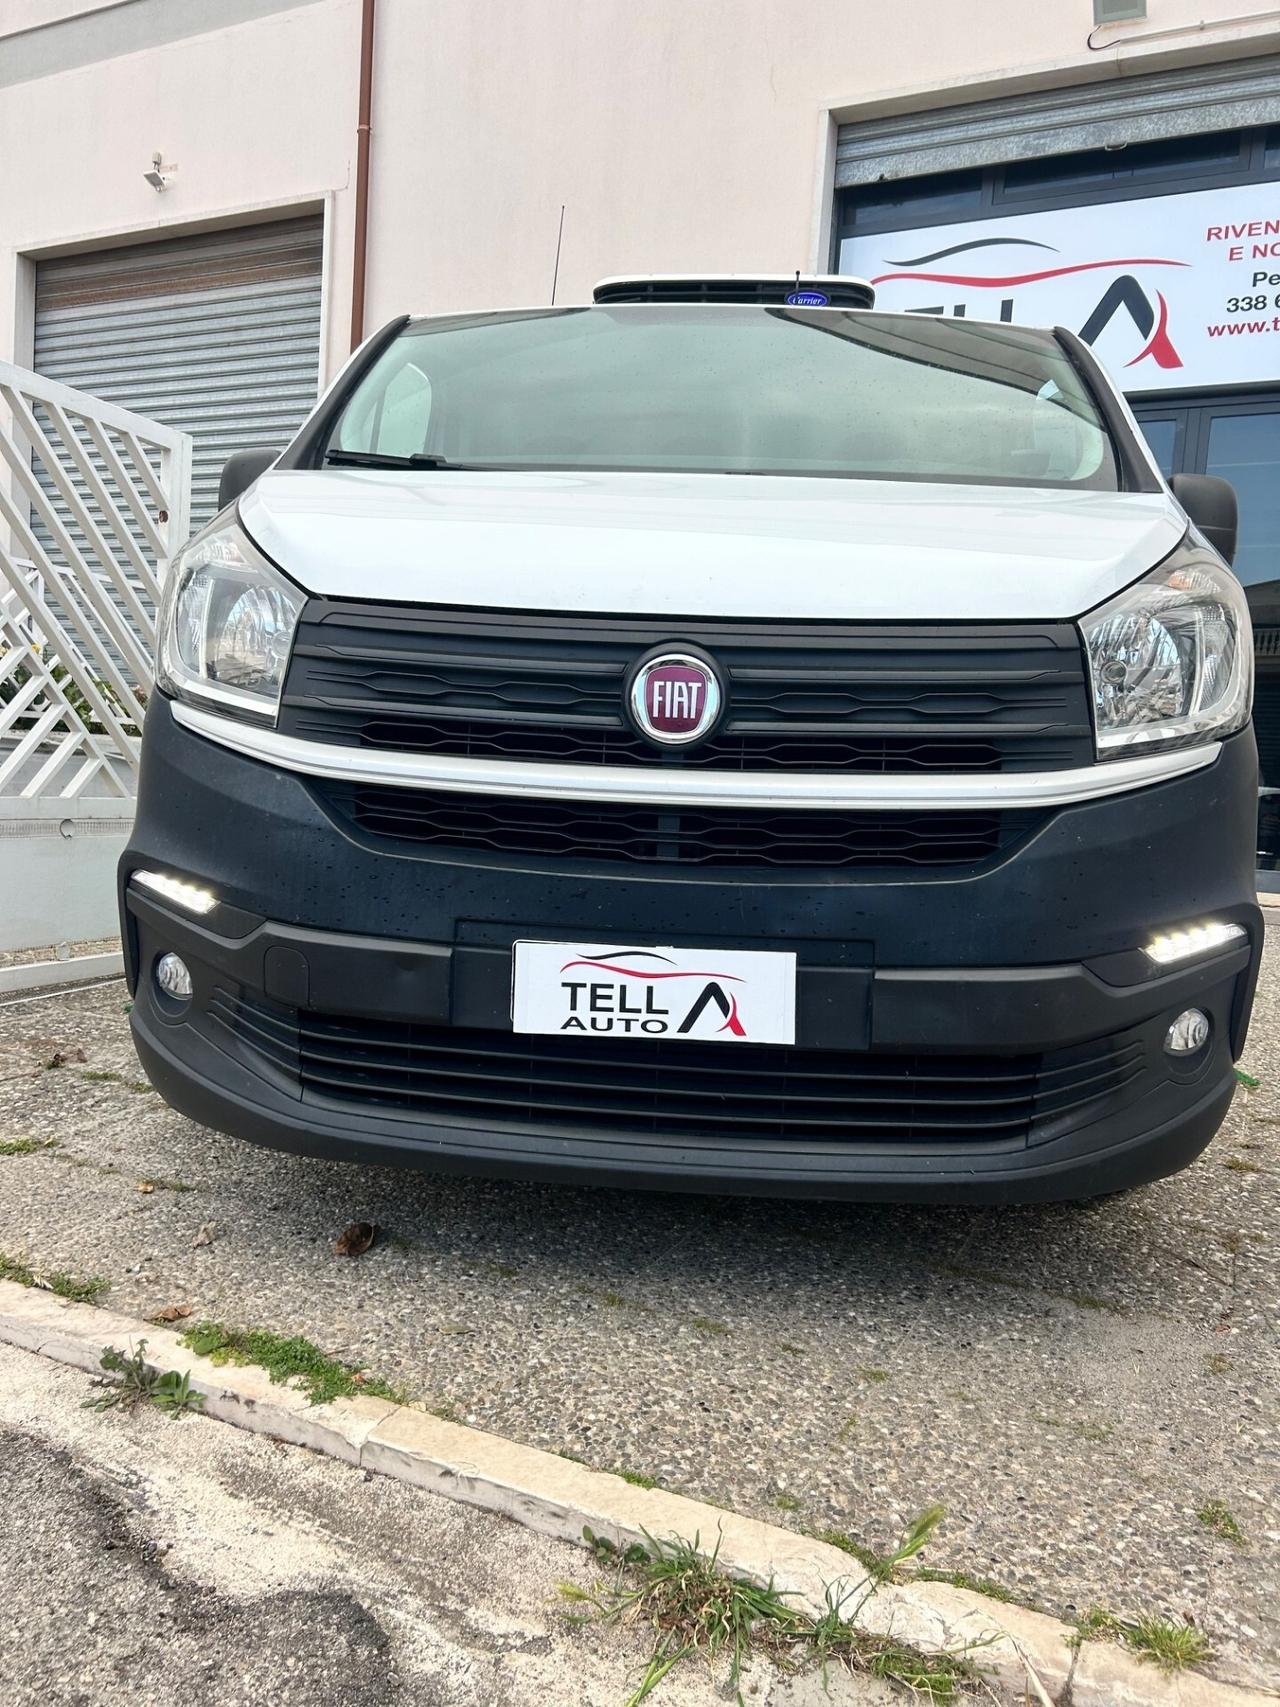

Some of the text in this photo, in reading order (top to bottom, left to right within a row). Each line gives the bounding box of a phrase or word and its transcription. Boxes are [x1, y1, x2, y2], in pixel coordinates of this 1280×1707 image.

[1206, 219, 1280, 241] RIVEN
[1229, 246, 1244, 261] E
[1252, 271, 1280, 287] Pe
[1226, 294, 1267, 313] 338
[652, 681, 702, 719] FIAT
[560, 1016, 668, 1034] AUTO
